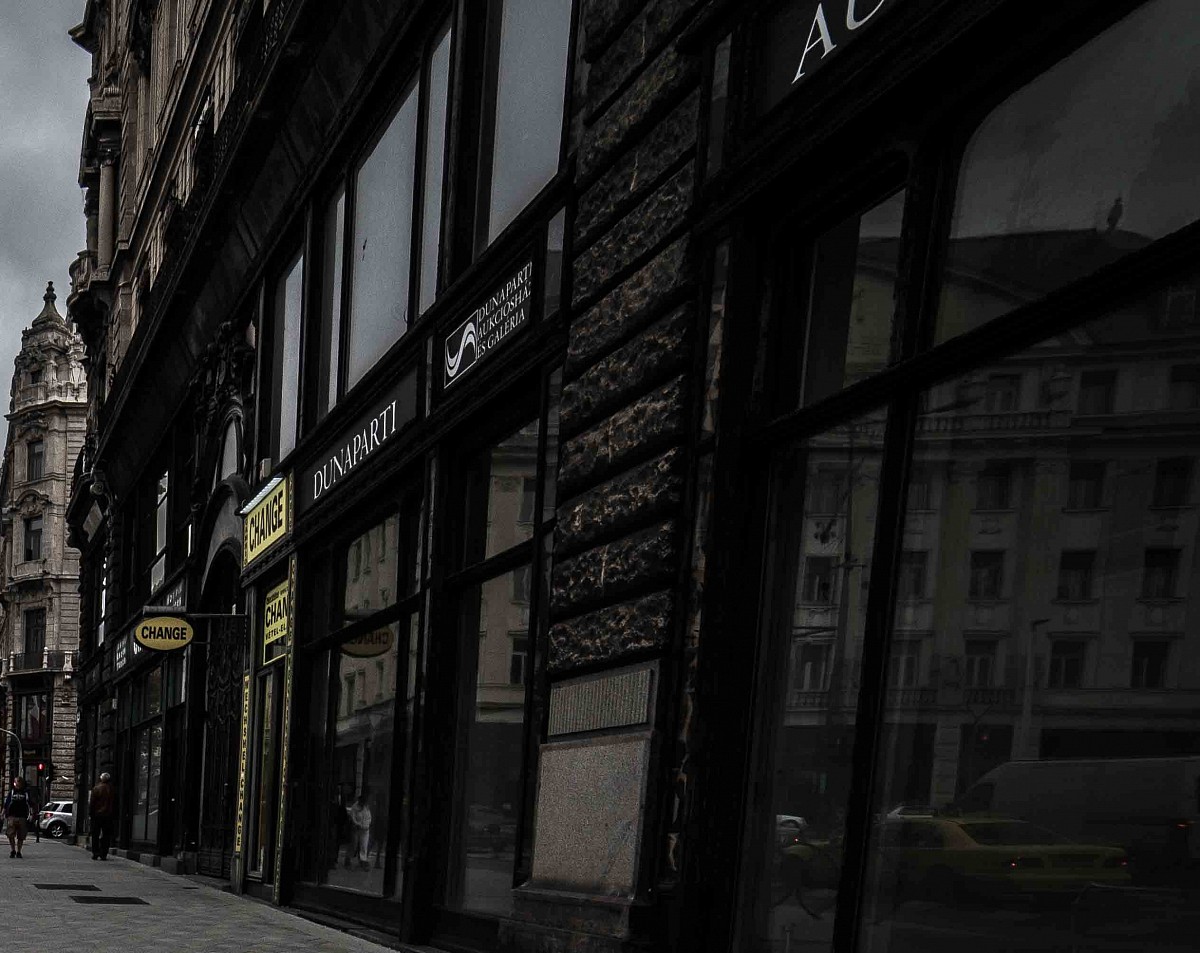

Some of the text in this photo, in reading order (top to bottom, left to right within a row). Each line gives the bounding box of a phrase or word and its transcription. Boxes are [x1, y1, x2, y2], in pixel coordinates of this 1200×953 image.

[478, 261, 531, 322] DUNAPARTI
[487, 308, 525, 349] GALÉRIA
[313, 400, 396, 500] DUNAPARTI
[249, 490, 283, 552] CHANGE
[141, 626, 187, 640] CHANGE
